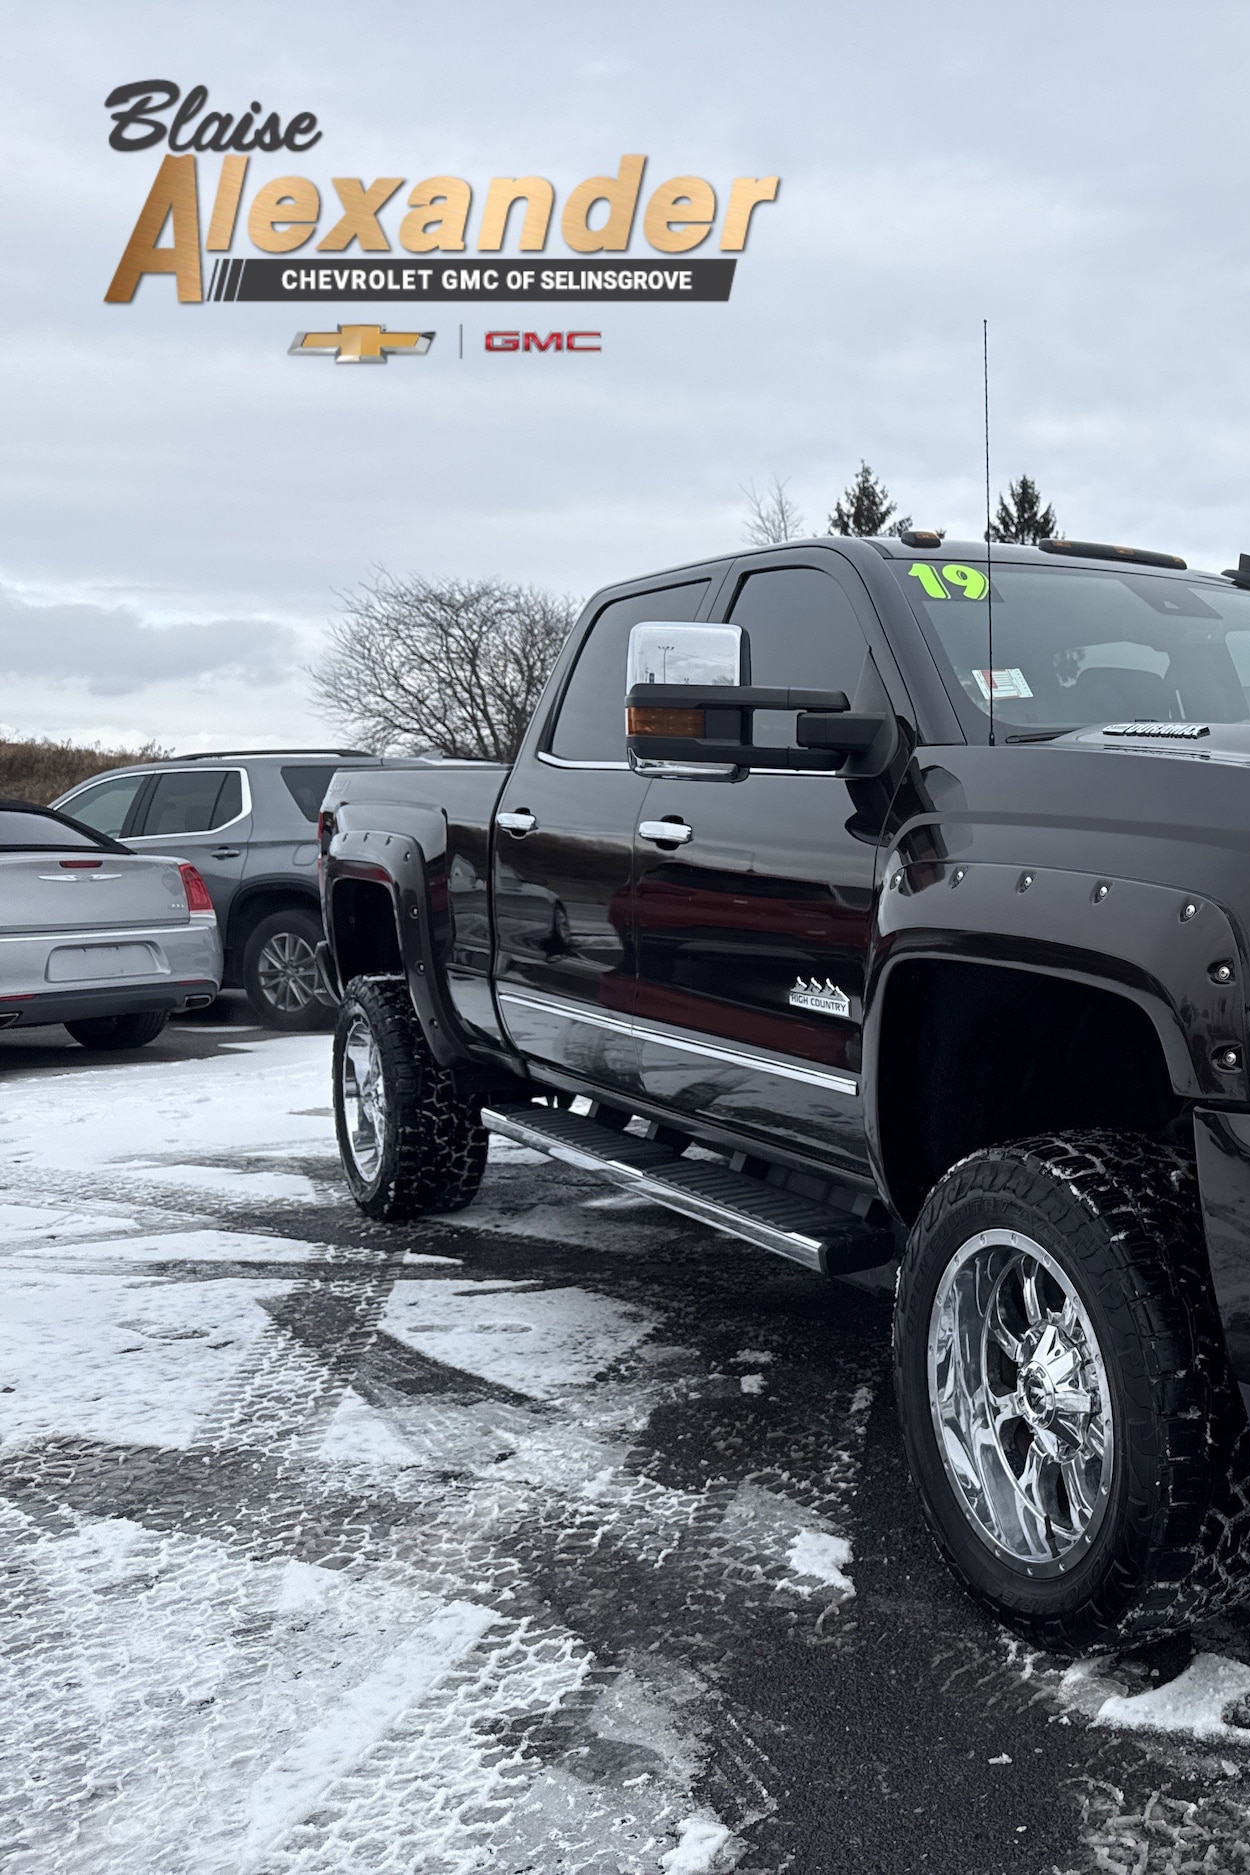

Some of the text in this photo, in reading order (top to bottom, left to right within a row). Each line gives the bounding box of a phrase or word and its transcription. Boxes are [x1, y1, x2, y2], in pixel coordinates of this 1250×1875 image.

[908, 562, 990, 600] 19
[791, 993, 847, 1013] HIGH COUNTRY
